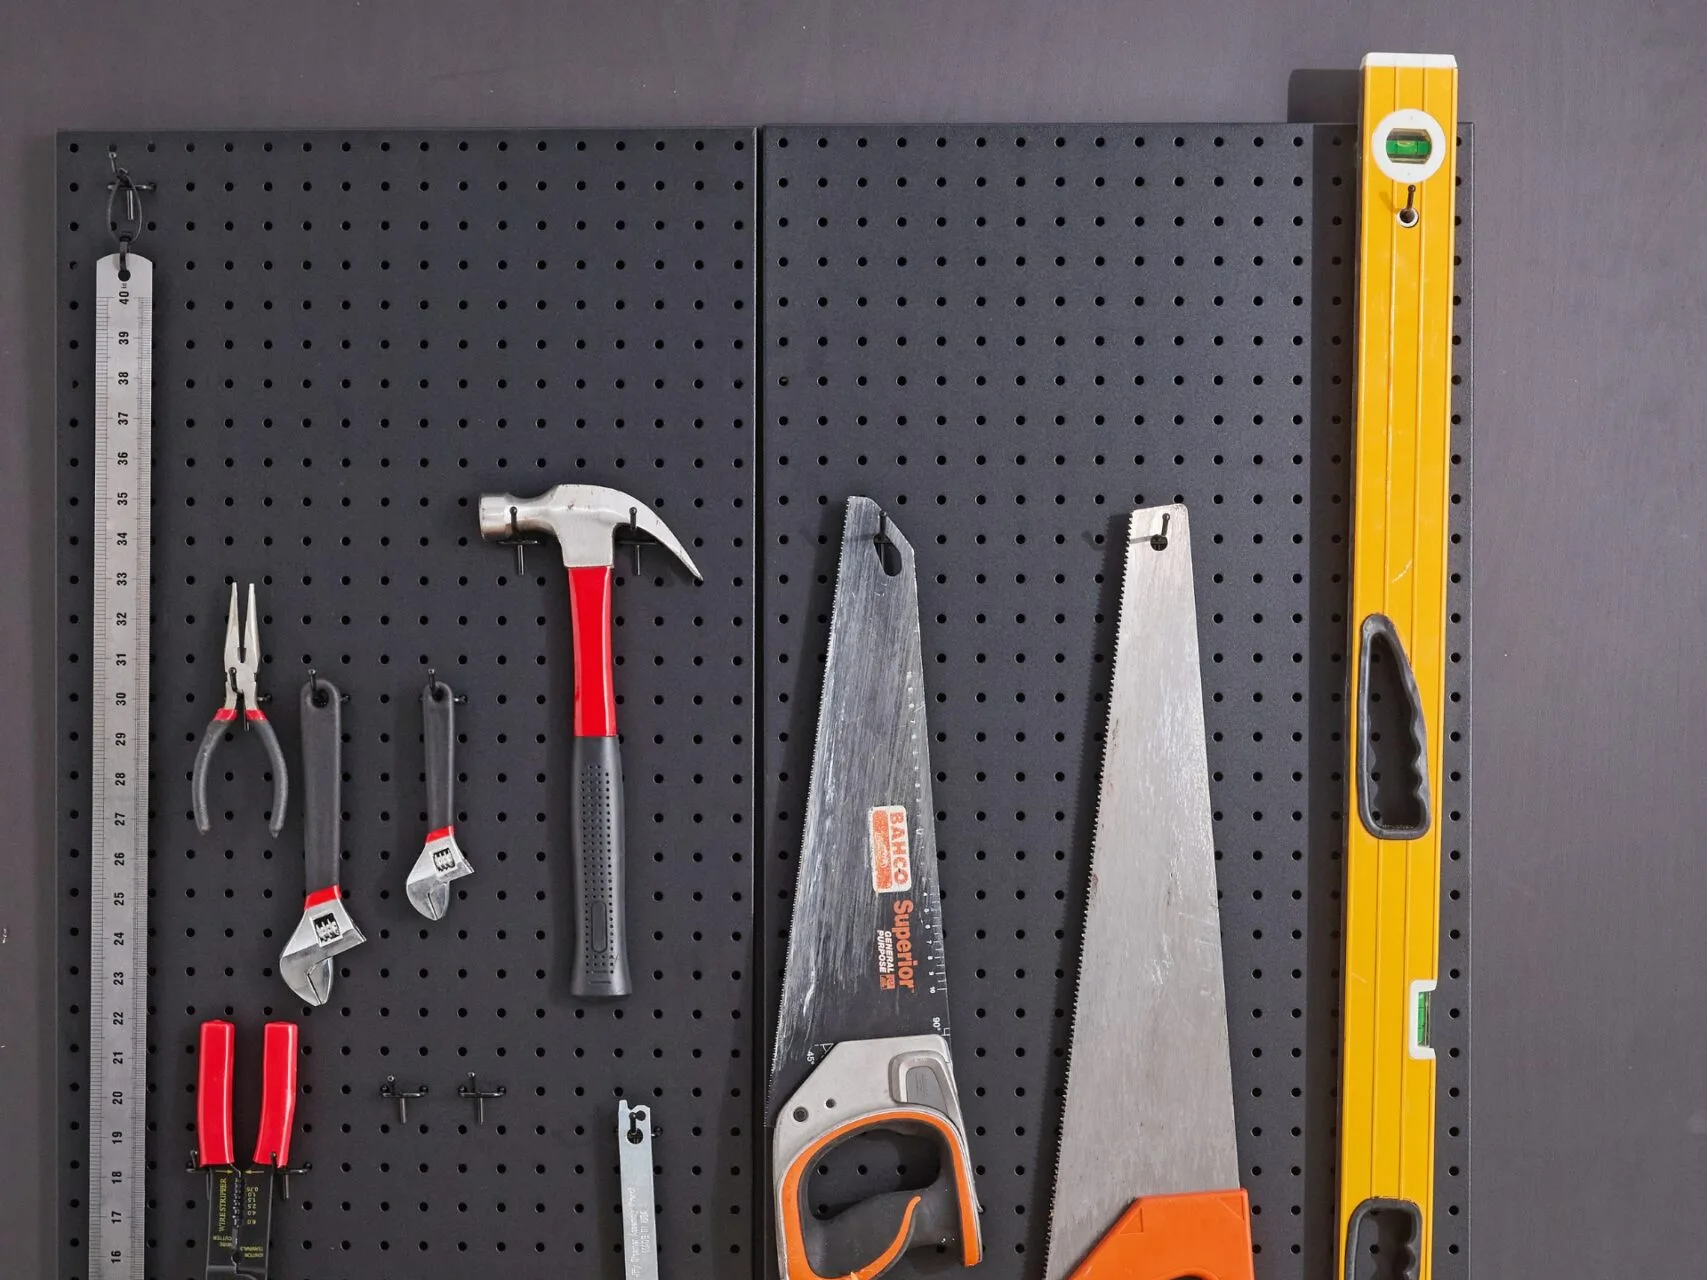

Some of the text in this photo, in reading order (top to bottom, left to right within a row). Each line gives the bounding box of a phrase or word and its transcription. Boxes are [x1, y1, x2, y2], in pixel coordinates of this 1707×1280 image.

[119, 291, 129, 304] 40
[119, 332, 128, 344] 39
[118, 372, 128, 385] 38
[118, 412, 128, 425] 37
[118, 452, 128, 465] 36
[117, 493, 127, 505] 35
[117, 533, 127, 545] 34
[117, 573, 127, 585] 33
[117, 613, 126, 625] 32
[116, 654, 126, 665] 31
[116, 693, 126, 705] 30
[116, 733, 125, 746] 29
[115, 773, 125, 785] 28
[115, 813, 125, 825] 27
[890, 812, 908, 884] BAHCO
[114, 853, 124, 865] 26
[114, 893, 124, 905] 25
[114, 932, 124, 945] 24
[892, 900, 918, 989] Superior
[877, 930, 886, 973] PURPOSE
[885, 931, 894, 973] GENERAL
[113, 972, 123, 985] 23
[113, 1012, 123, 1025] 22
[113, 1052, 123, 1064] 21
[113, 1092, 122, 1104] 20
[112, 1132, 122, 1144] 19
[112, 1172, 121, 1184] 18
[112, 1211, 121, 1224] 17
[111, 1251, 121, 1263] 16
